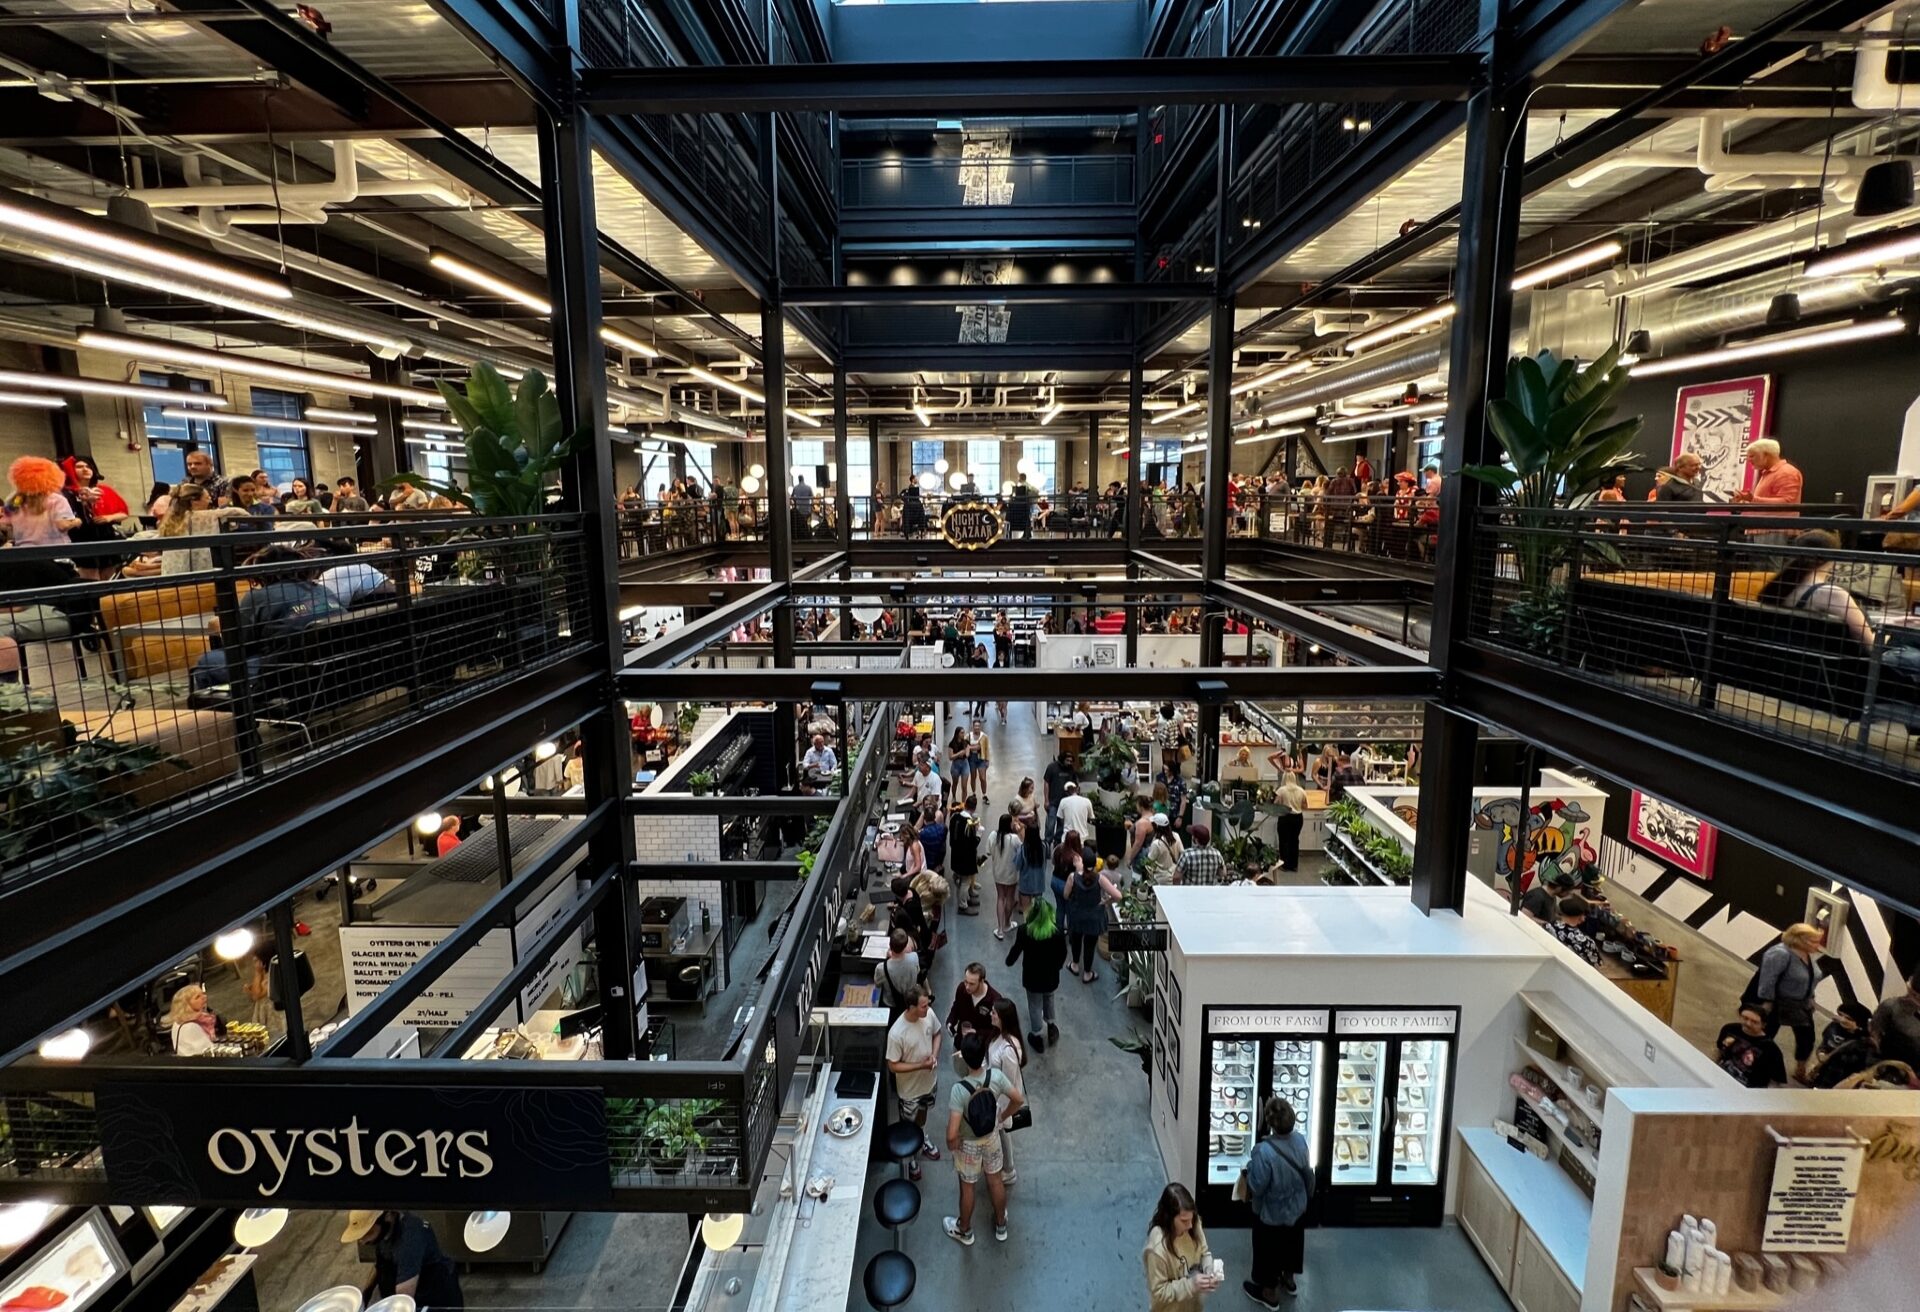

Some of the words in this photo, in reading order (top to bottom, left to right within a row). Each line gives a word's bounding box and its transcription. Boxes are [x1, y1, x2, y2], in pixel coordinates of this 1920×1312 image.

[951, 512, 980, 532] NIGHT
[955, 524, 993, 541] BAZAAR
[825, 871, 843, 943] bar
[796, 927, 823, 1037] raw
[1213, 1016, 1251, 1027] FROM
[1254, 1016, 1281, 1027] OUR
[1285, 1016, 1324, 1027] FARM
[1340, 1016, 1359, 1028] TO
[1362, 1016, 1398, 1028] YOUR
[1402, 1016, 1453, 1028] FAMILY
[207, 1114, 494, 1197] oysters
